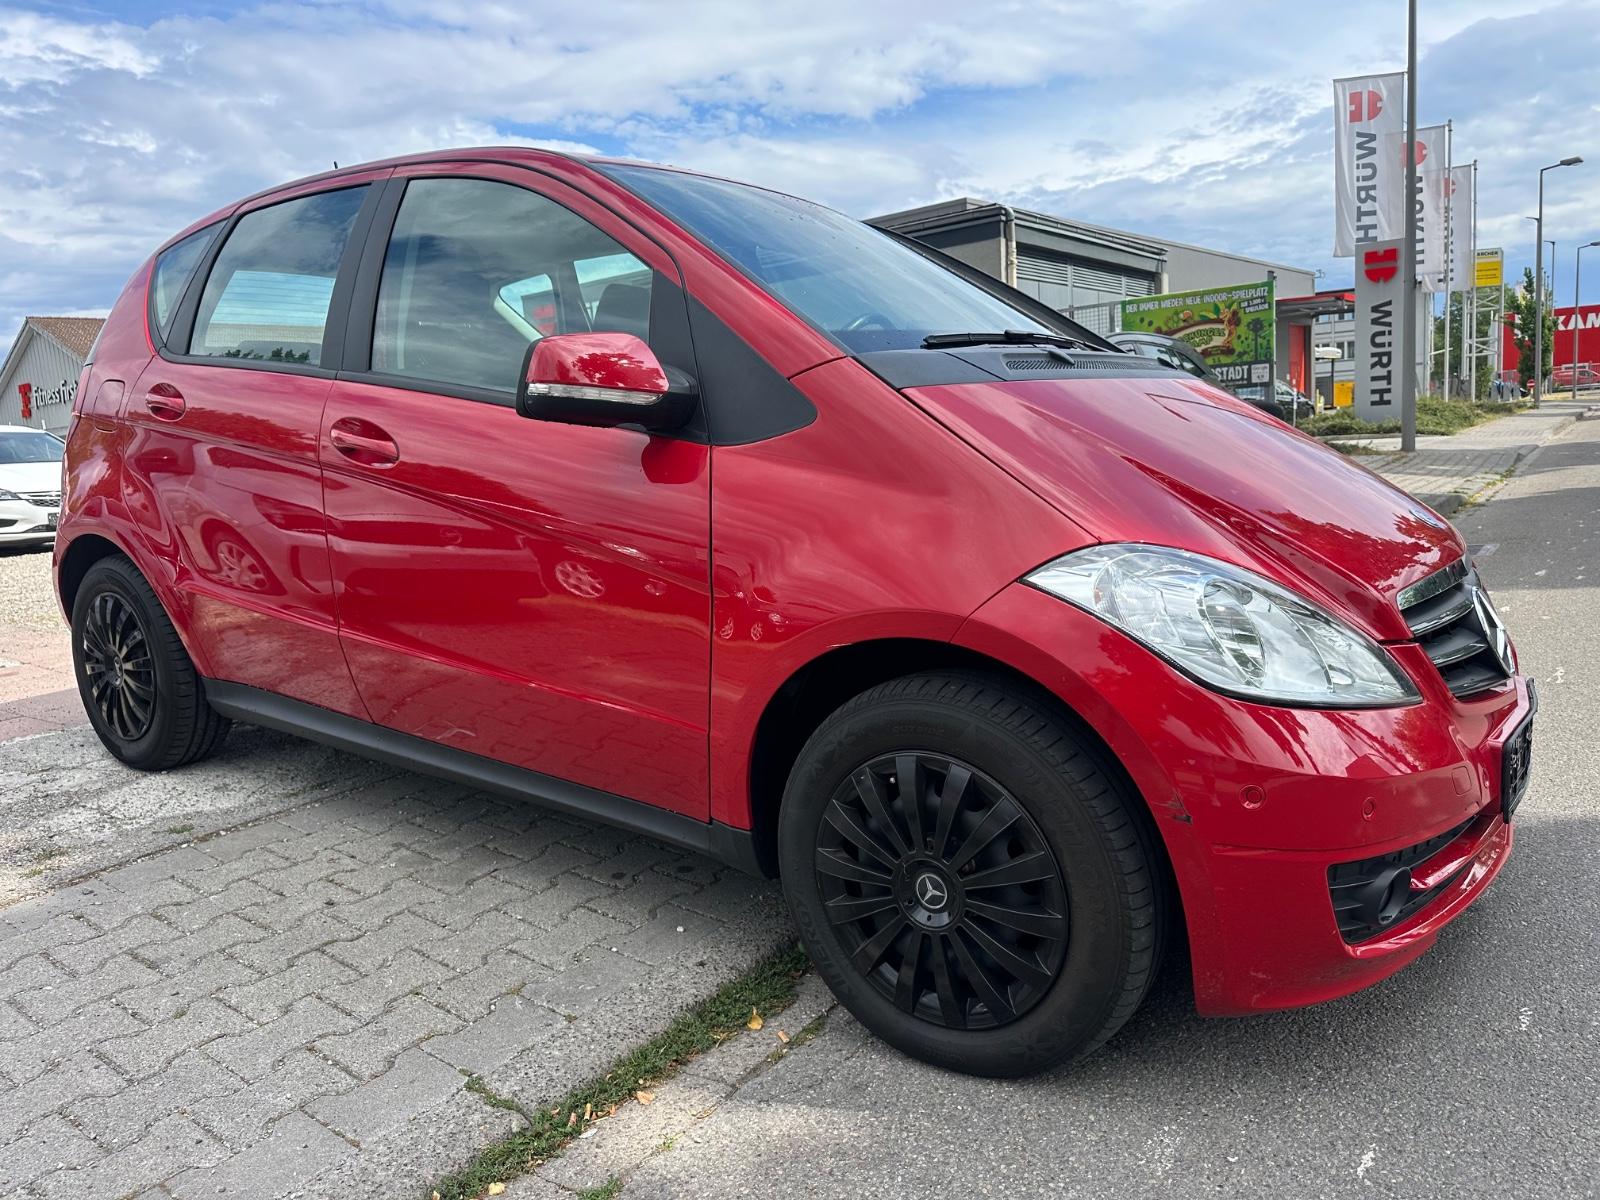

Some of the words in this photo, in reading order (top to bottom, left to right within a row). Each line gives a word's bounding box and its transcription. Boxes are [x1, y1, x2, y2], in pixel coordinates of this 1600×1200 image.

[1126, 303, 1138, 313] DER
[1139, 301, 1159, 311] IMMER
[1161, 298, 1184, 309] WIEDER
[1186, 295, 1201, 305] NEUE
[1203, 287, 1268, 302] INDOOR-SPIELPLATZ
[1370, 299, 1393, 407] WÜRTH
